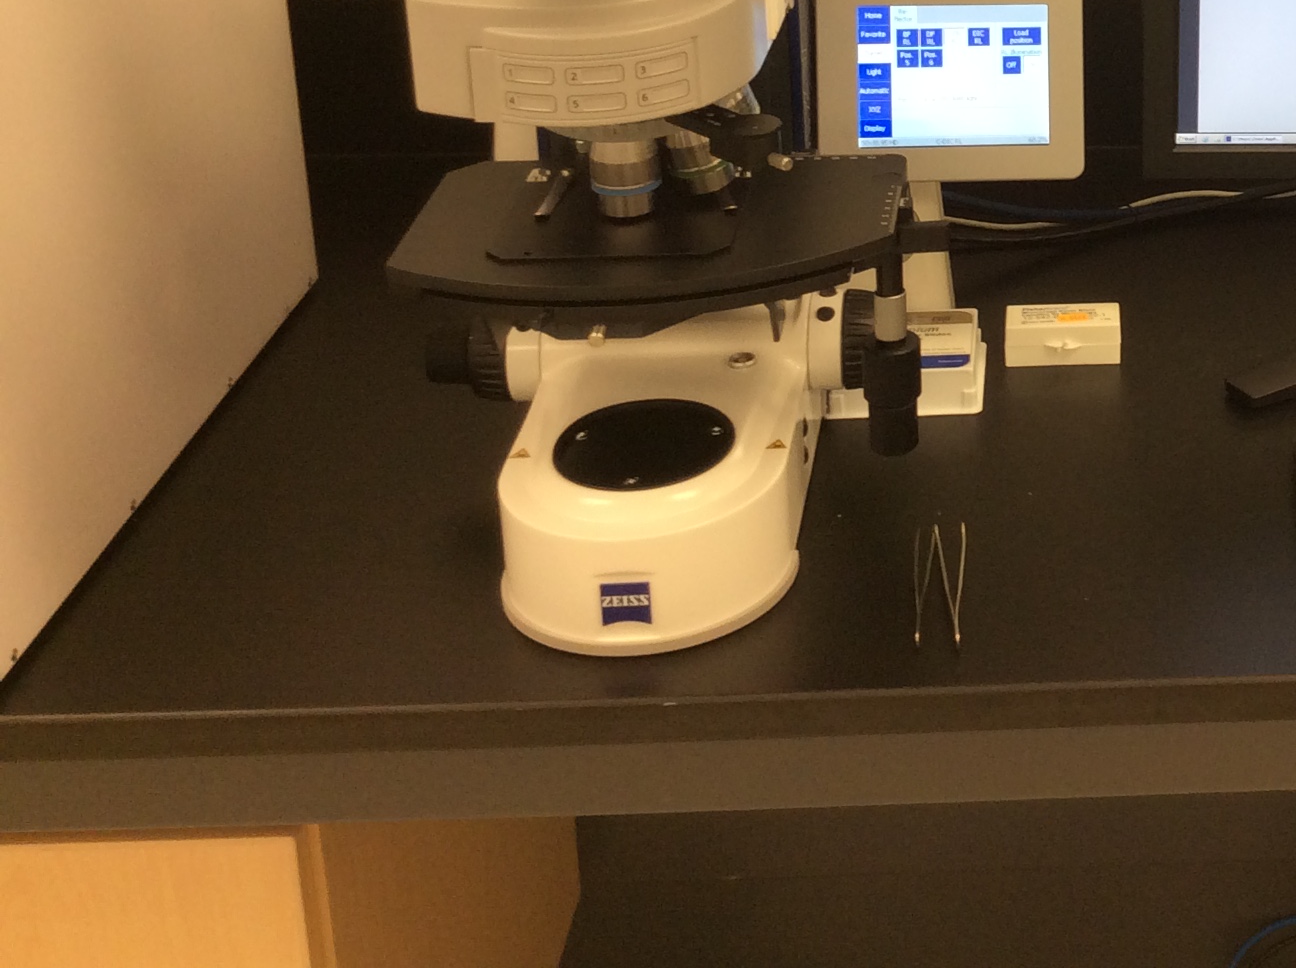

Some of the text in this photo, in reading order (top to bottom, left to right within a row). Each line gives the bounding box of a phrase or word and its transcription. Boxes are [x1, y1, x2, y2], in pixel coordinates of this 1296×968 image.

[864, 12, 883, 20] Home
[860, 30, 887, 39] Favorite
[1013, 29, 1030, 37] Load
[1009, 37, 1034, 46] position
[639, 65, 647, 76] 3
[866, 68, 883, 77] Light
[569, 71, 578, 82] 2
[858, 87, 890, 95] Automatic
[508, 96, 516, 105] 4
[640, 92, 649, 103] 6
[571, 98, 580, 109] 5
[863, 124, 887, 133] Display
[601, 593, 650, 608] ZEISS
